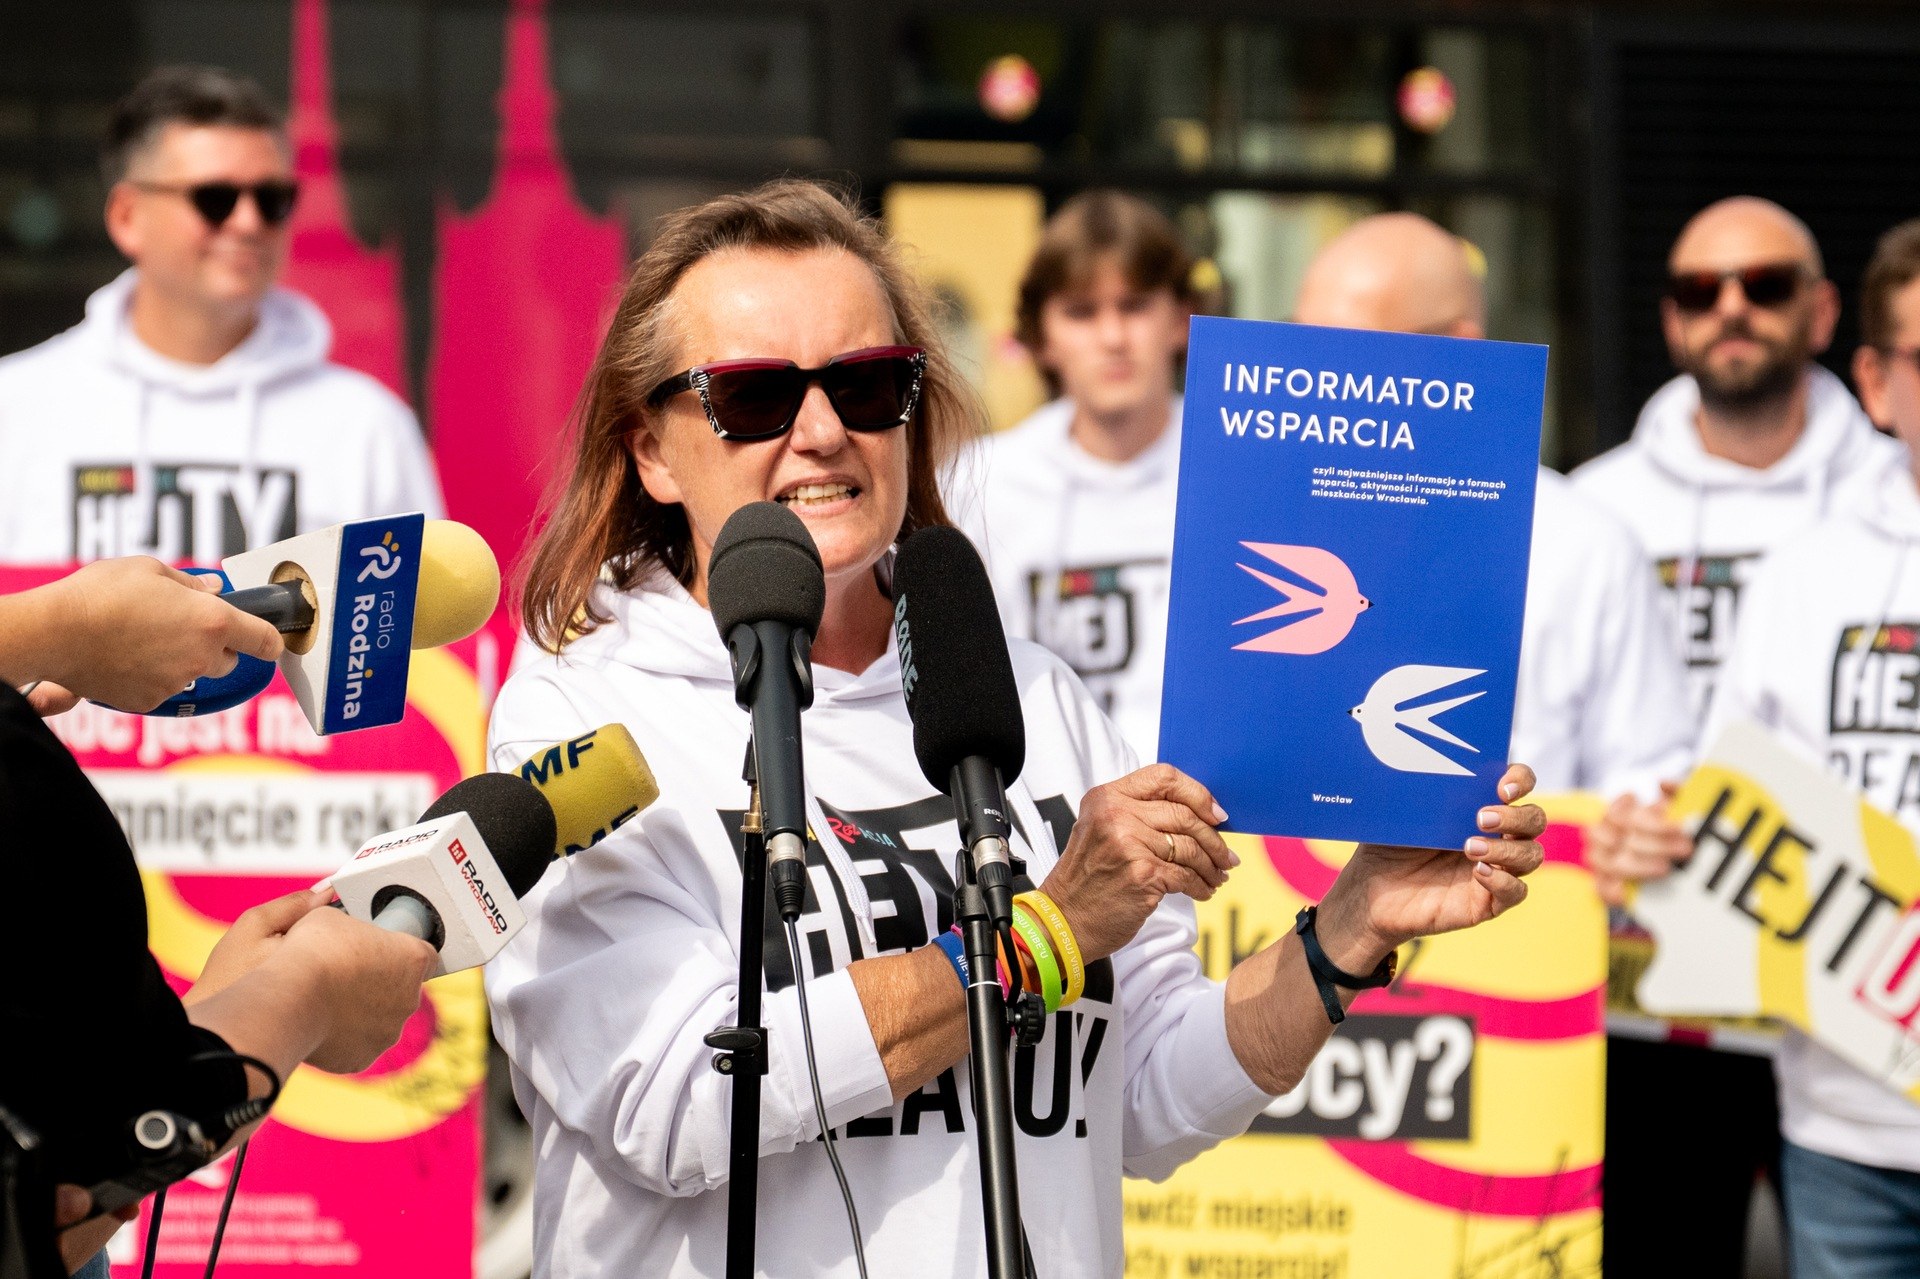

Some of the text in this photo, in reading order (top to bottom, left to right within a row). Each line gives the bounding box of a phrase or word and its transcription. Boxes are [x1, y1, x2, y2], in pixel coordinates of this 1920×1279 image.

[1224, 363, 1474, 411] INFORMATOR
[1220, 407, 1415, 450] WSPARCIA
[1312, 487, 1374, 500] mieszkańców
[1313, 467, 1335, 476] czyli
[1337, 469, 1403, 481] najważniejsze
[1406, 473, 1456, 486] informacje
[1467, 477, 1506, 489] formach
[1313, 478, 1358, 490] wsparcia,
[1361, 482, 1412, 494] aktywności
[1421, 486, 1457, 497] rozwoju
[1460, 489, 1499, 501] młodych
[377, 590, 395, 649] radio
[343, 593, 376, 720] Rodzina
[1313, 793, 1353, 804] Wrocław
[461, 866, 502, 935] WROCŁAW
[464, 860, 508, 932] RADIO
[1027, 928, 1048, 959] VIBE'U
[1050, 914, 1063, 930] NIE
[1059, 931, 1074, 954] PSUJ
